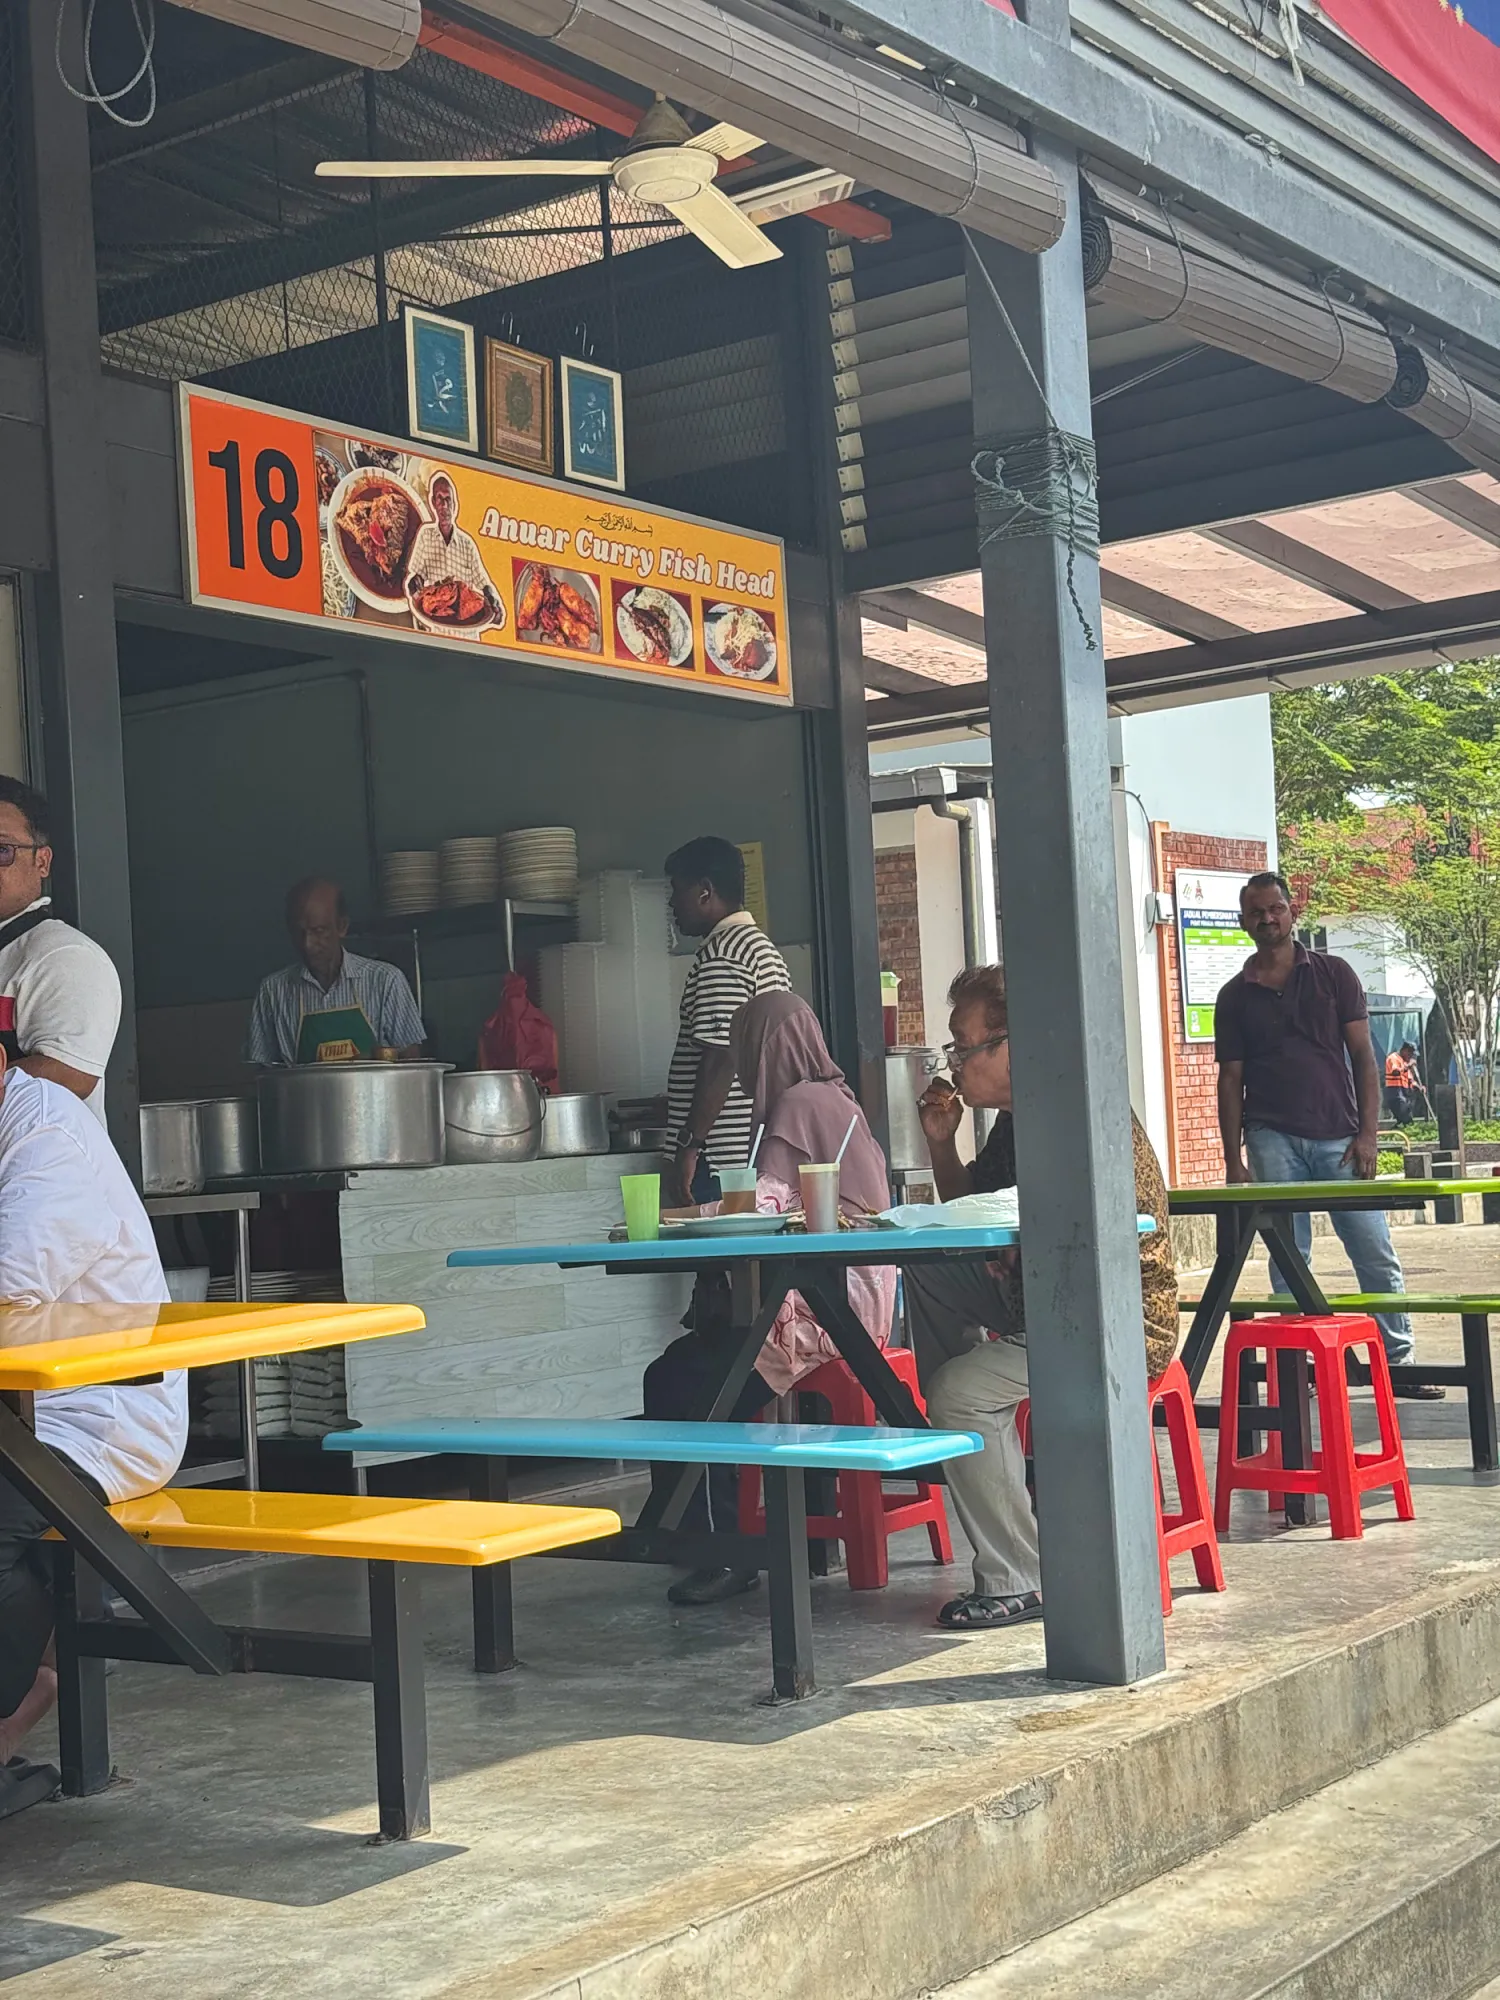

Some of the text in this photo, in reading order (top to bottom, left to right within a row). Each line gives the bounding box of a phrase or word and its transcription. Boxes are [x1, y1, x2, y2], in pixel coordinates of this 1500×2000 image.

[208, 440, 303, 579] 18
[479, 507, 776, 598] Anuar Curry Fish Head
